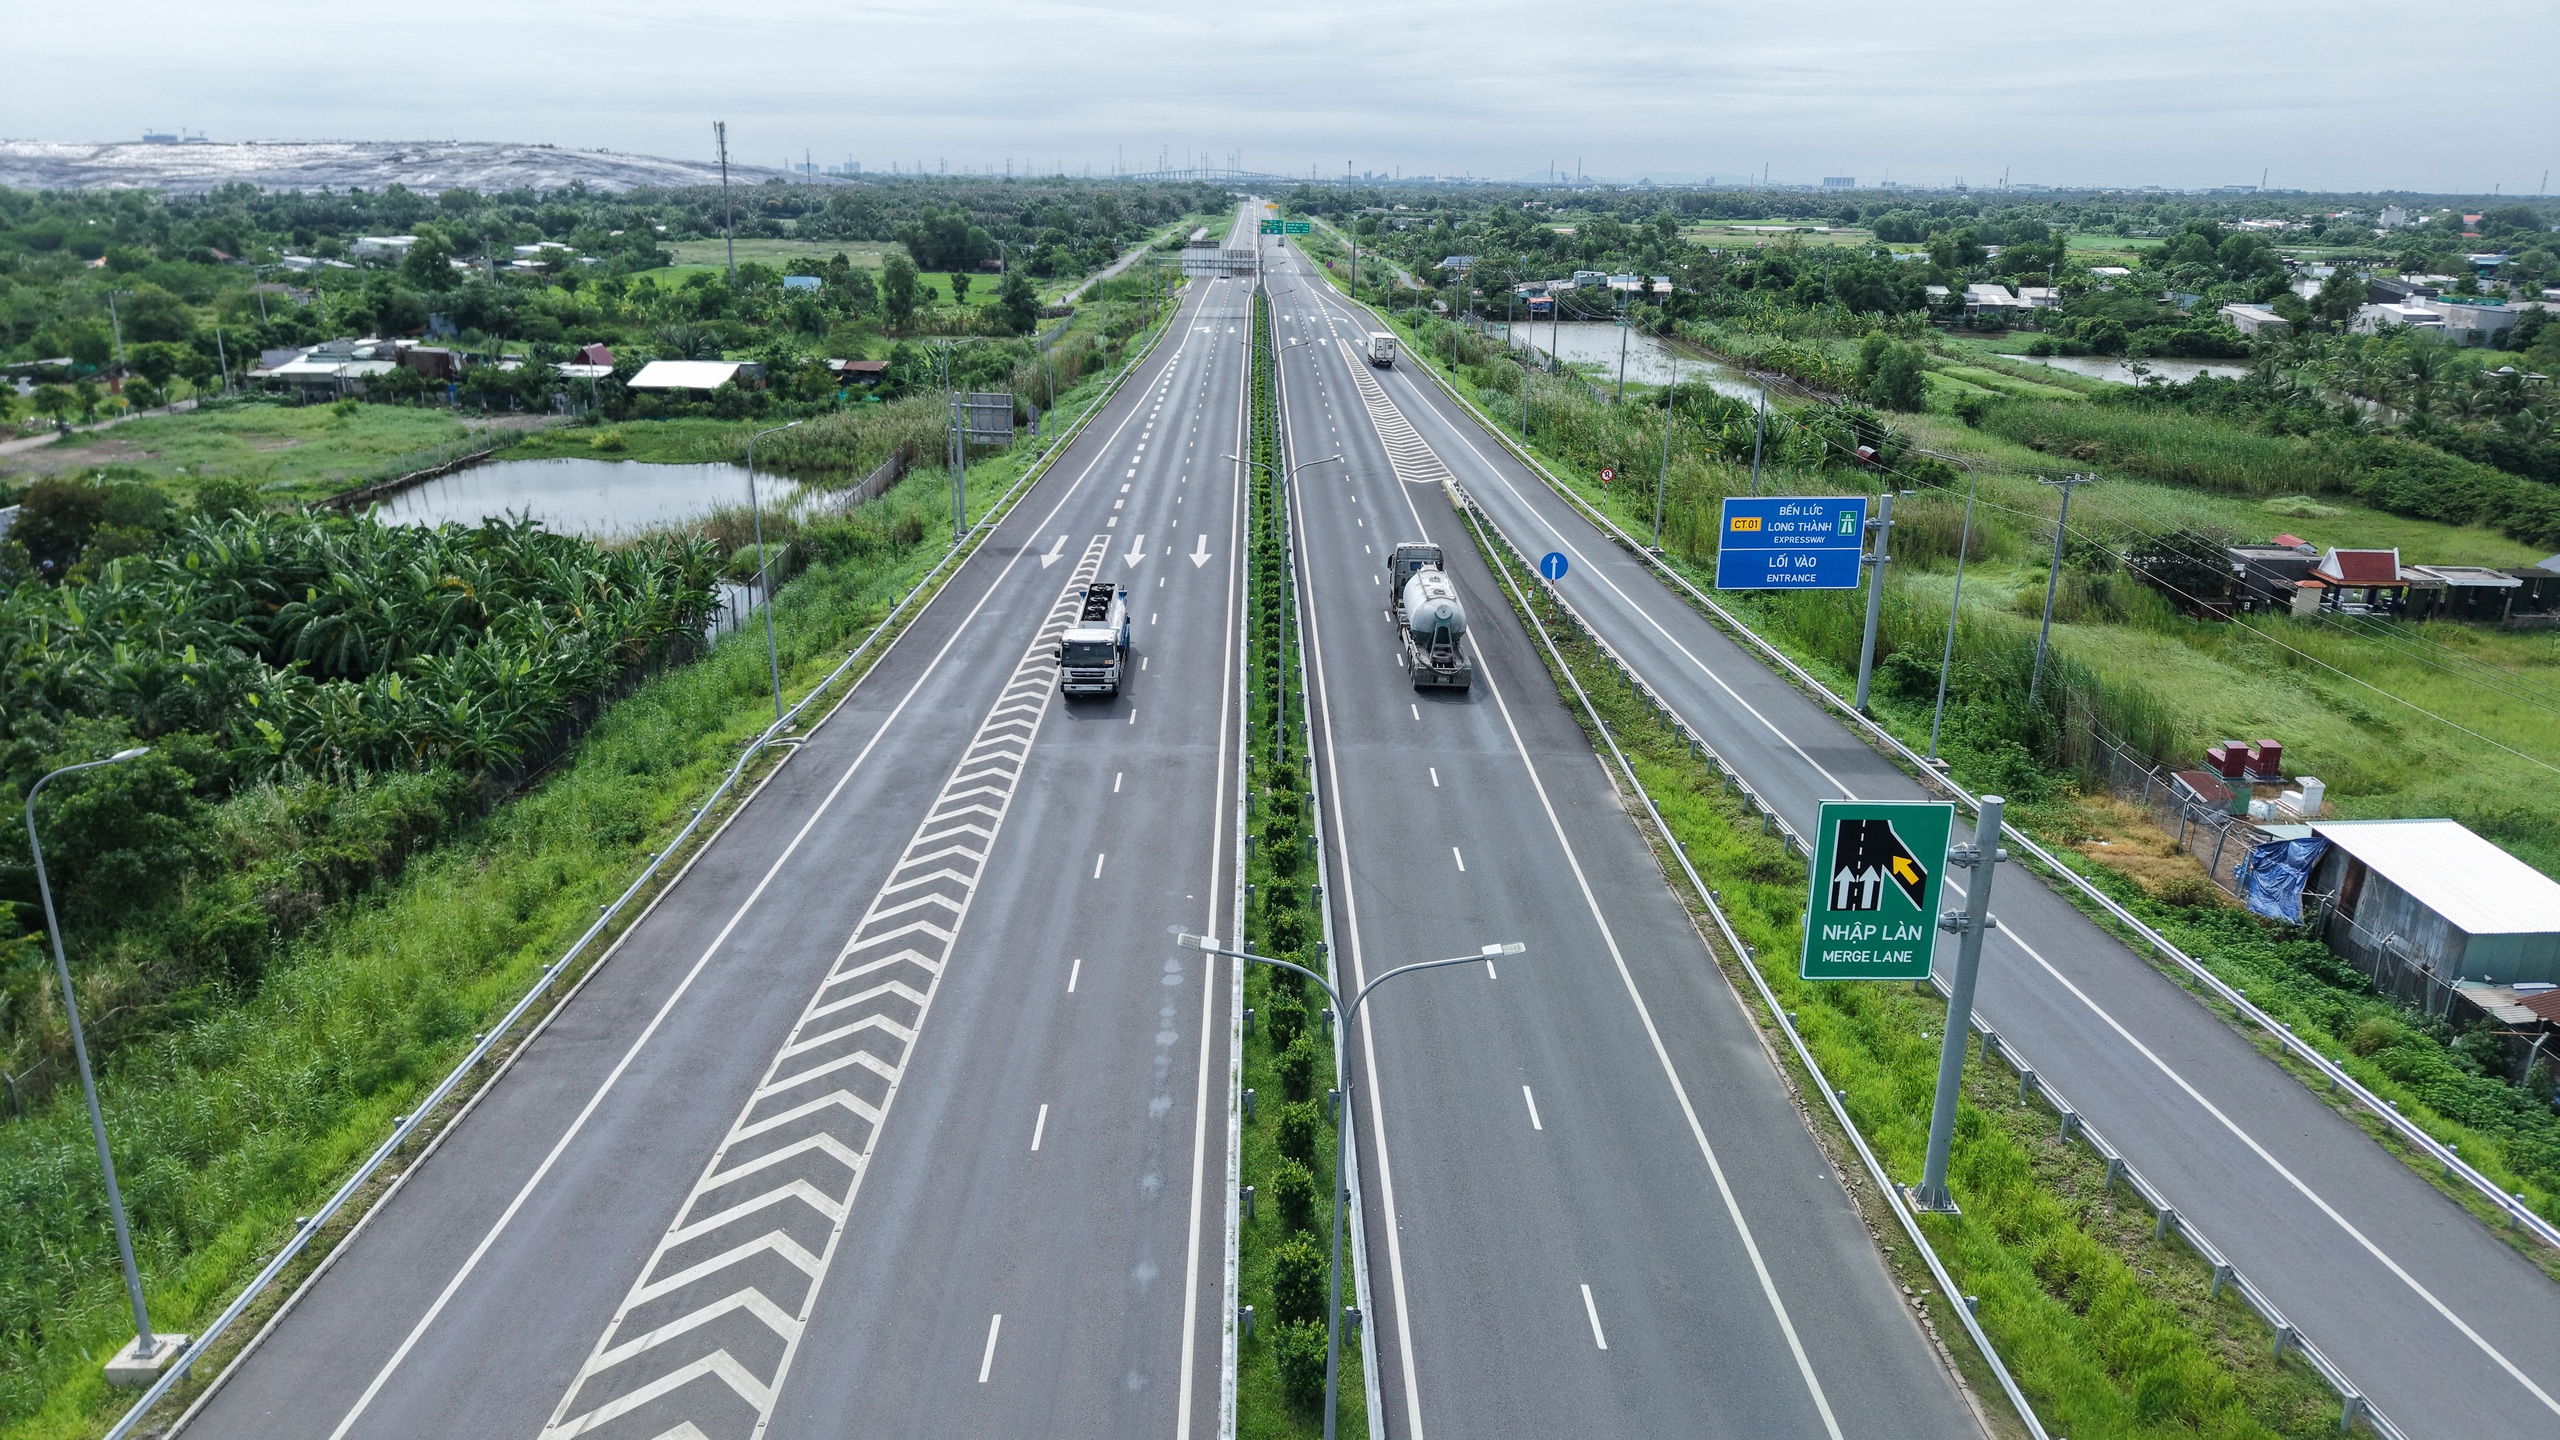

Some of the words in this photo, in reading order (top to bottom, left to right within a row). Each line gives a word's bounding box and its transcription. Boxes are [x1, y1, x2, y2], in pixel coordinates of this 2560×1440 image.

[1779, 503, 1800, 516] BẾN
[1803, 503, 1823, 516] LỨC
[1734, 520, 1758, 529] CT.01
[1767, 522, 1795, 532] LONG
[1798, 519, 1832, 532] THÀNH
[1773, 536, 1826, 544] EXPRESSWAY
[1768, 553, 1788, 568] LỐI
[1794, 554, 1817, 568] VÀO
[1766, 574, 1817, 583] ENTRANCE
[1822, 921, 1877, 944] NHẬP
[1882, 920, 1923, 941] LÀN
[1822, 950, 1871, 963] MERGE
[1873, 950, 1913, 963] LANE
